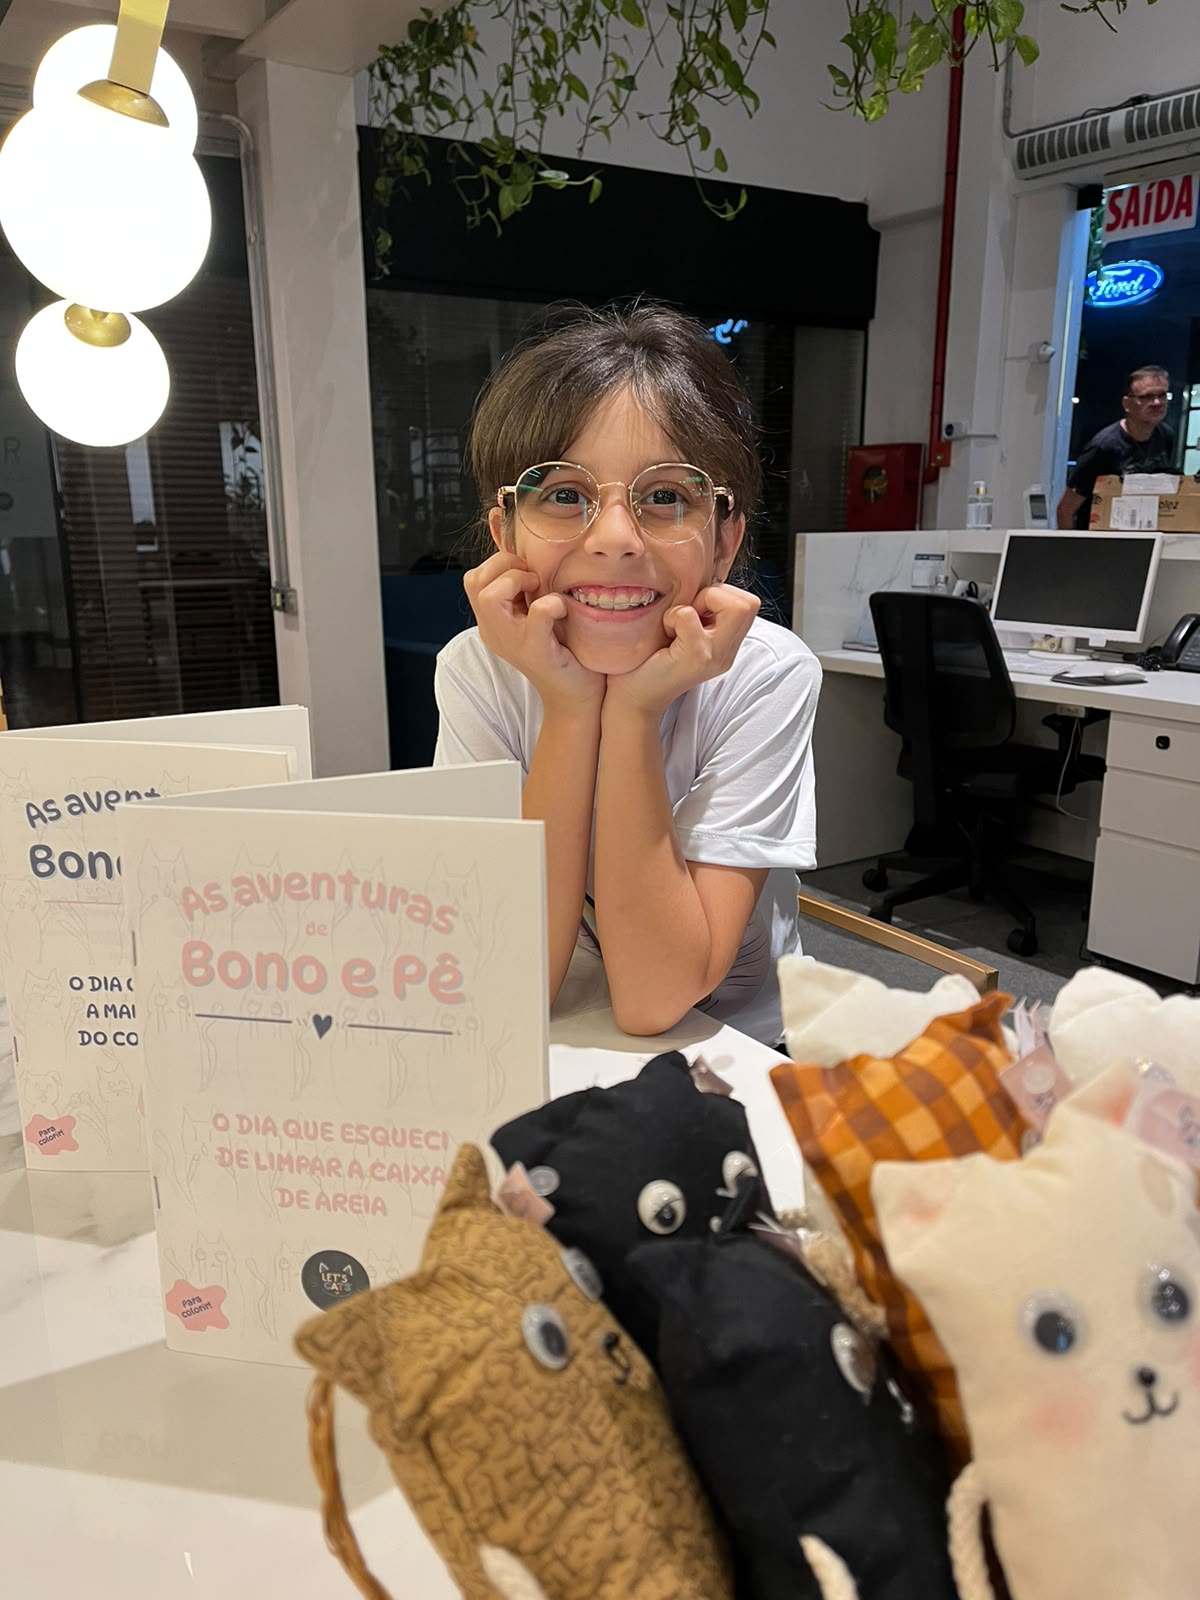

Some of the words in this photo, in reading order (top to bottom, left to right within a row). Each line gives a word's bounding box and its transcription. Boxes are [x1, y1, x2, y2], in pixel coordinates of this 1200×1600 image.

[1089, 268, 1146, 300] Ford
[26, 799, 62, 829] As
[29, 844, 122, 880] Bon
[181, 885, 227, 921] As
[231, 869, 459, 935] aventuras
[305, 921, 329, 936] de
[181, 940, 328, 995] Bono
[341, 958, 379, 998] e
[393, 953, 466, 1005] Pê
[69, 976, 84, 991] O
[88, 976, 122, 992] DIA
[86, 1003, 100, 1019] A
[78, 1030, 108, 1046] DO
[38, 1126, 57, 1138] Para
[212, 1113, 230, 1132] O
[235, 1114, 277, 1137] DIA
[282, 1118, 335, 1142] QUE
[340, 1123, 448, 1150] ESQUECI
[216, 1147, 249, 1168] DE
[254, 1152, 342, 1178] LIMPAR
[347, 1159, 365, 1179] A
[369, 1161, 449, 1185] CAIXA
[277, 1188, 310, 1210] DE
[315, 1192, 388, 1217] AREIA
[321, 1272, 348, 1283] LET'S
[323, 1282, 353, 1293] CATS
[181, 1296, 203, 1309] Para
